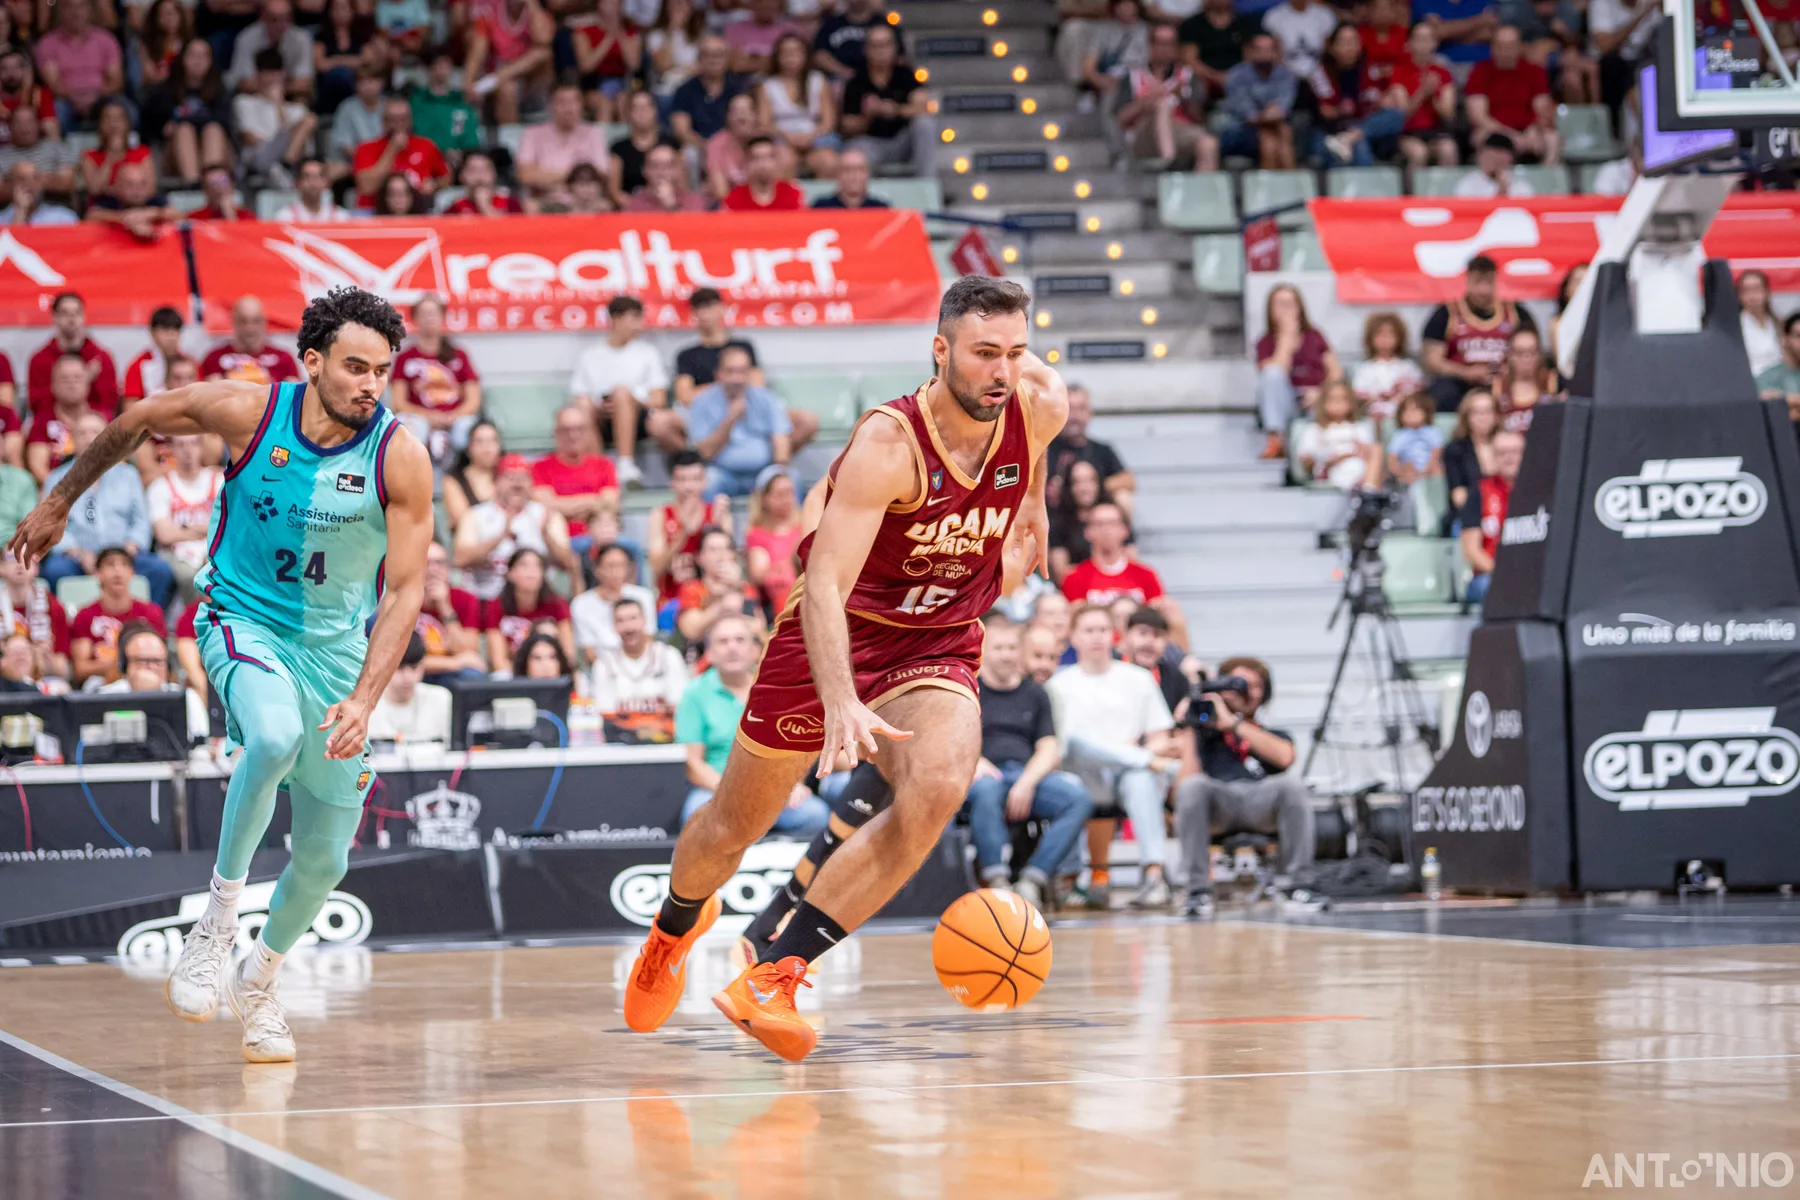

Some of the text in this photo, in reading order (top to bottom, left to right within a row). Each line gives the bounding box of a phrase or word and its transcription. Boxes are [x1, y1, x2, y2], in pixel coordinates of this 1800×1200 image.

[446, 229, 843, 293] realturf
[287, 515, 341, 534] Sanitària
[288, 503, 365, 525] Assistència
[904, 507, 1012, 544] UCAM
[909, 536, 985, 557] MURCIA
[274, 547, 328, 586] 24
[932, 569, 944, 577] DE
[895, 583, 958, 616] 15
[1582, 623, 1629, 647] Uno
[1675, 621, 1701, 643] de
[1702, 621, 1723, 642] la
[1723, 618, 1797, 646] familia
[893, 664, 942, 682] Juver
